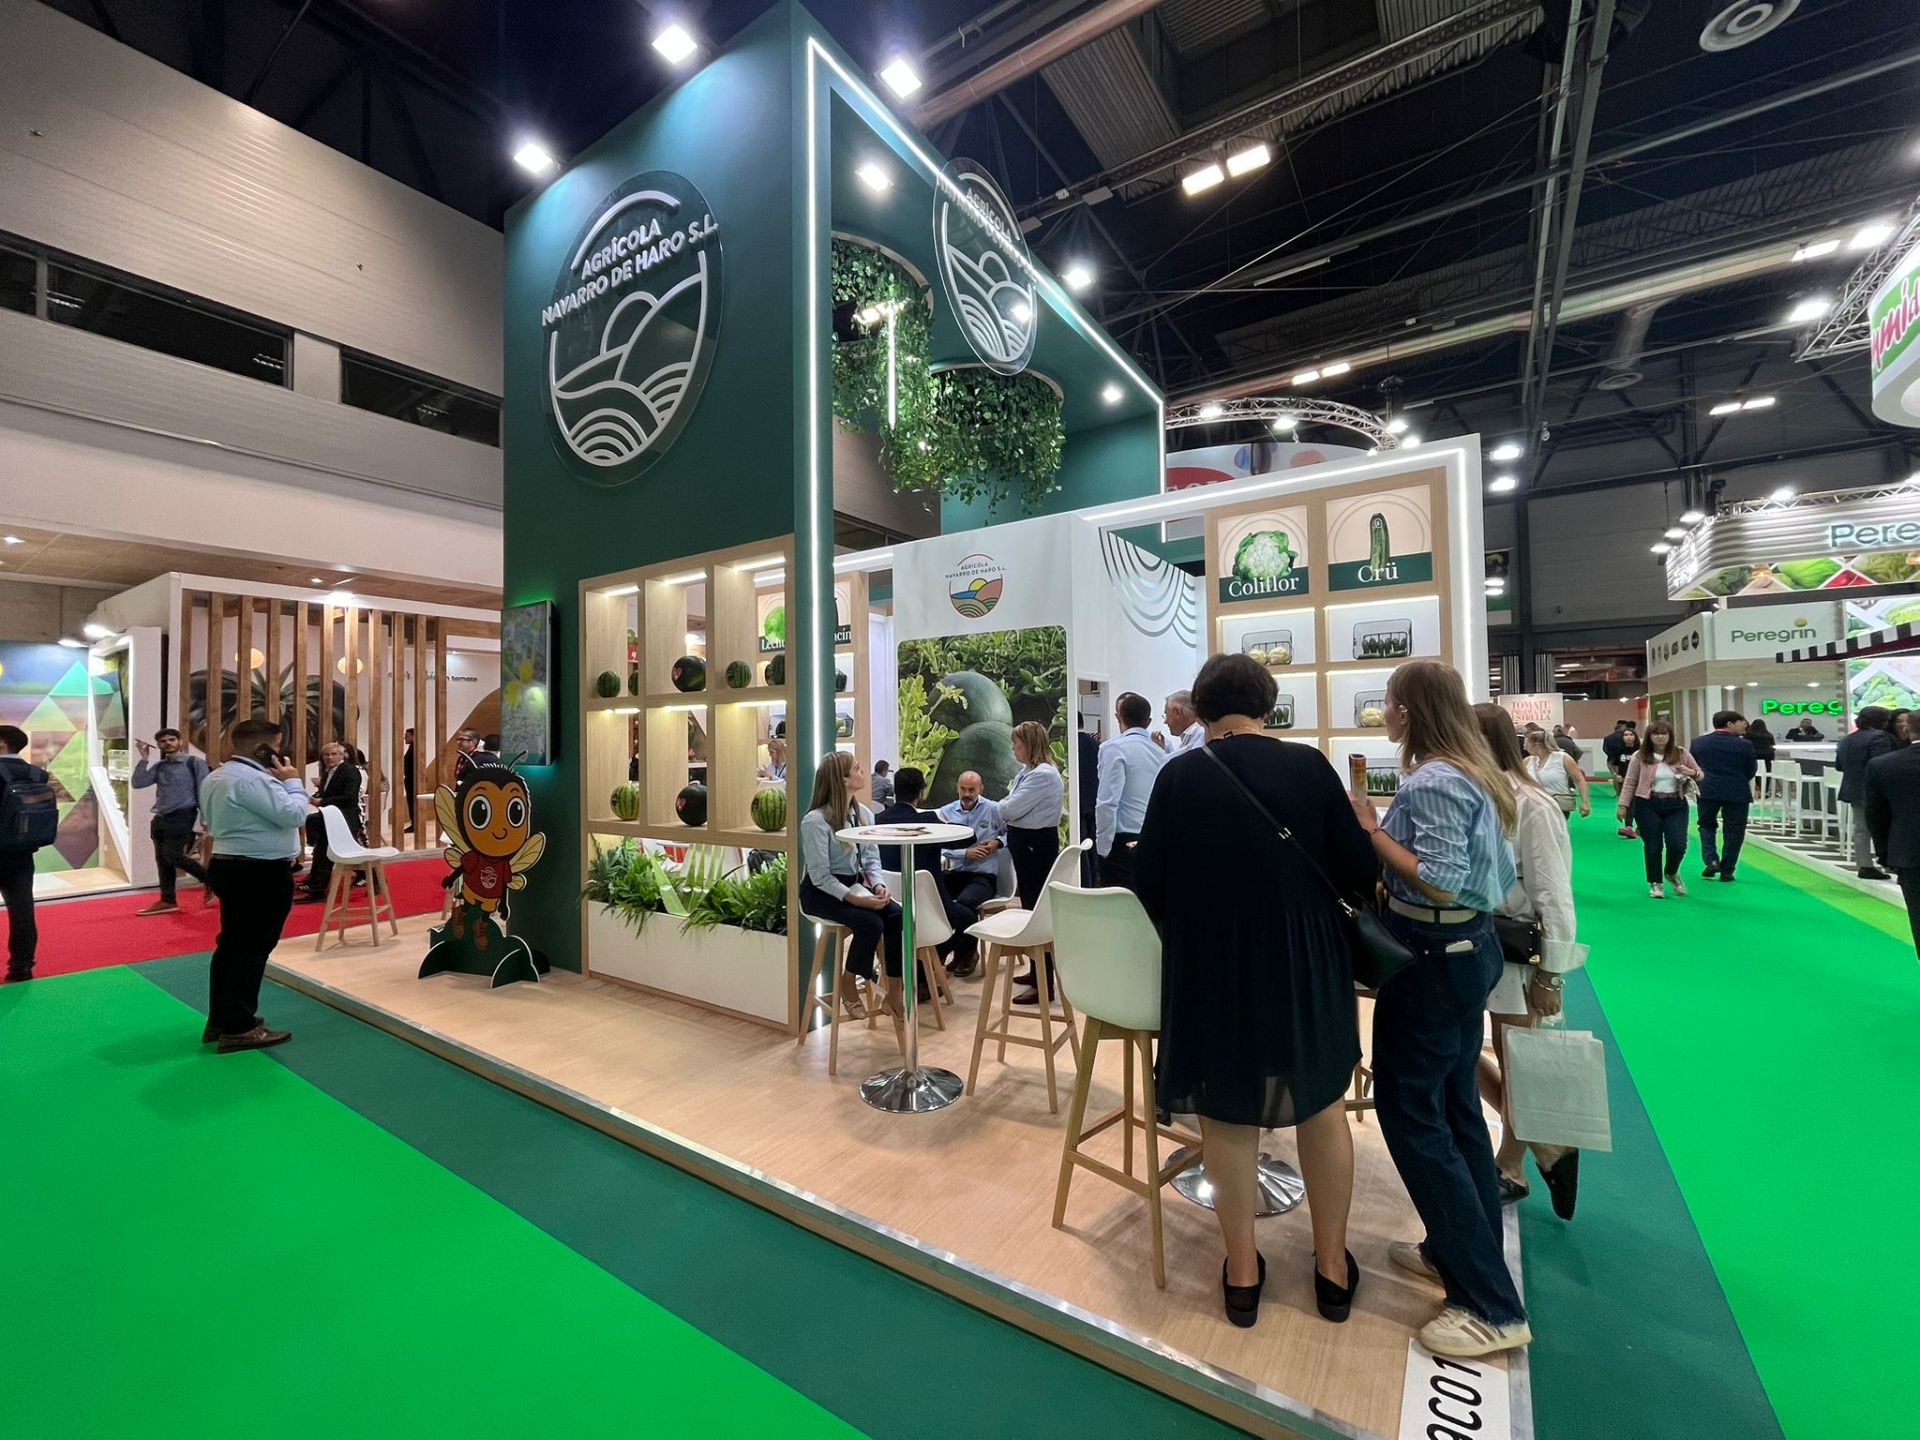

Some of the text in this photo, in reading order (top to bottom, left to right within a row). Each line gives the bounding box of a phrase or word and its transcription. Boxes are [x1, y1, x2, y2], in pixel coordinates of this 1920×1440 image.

[581, 218, 662, 280] AGRÍCOLA
[541, 274, 609, 327] NAVARRO
[611, 259, 633, 288] DE
[635, 231, 686, 274] HARO
[1831, 522, 1920, 547] Pere
[1357, 562, 1399, 583] Crü
[1228, 575, 1300, 598] Coliflor
[1731, 626, 1817, 643] Peregrin
